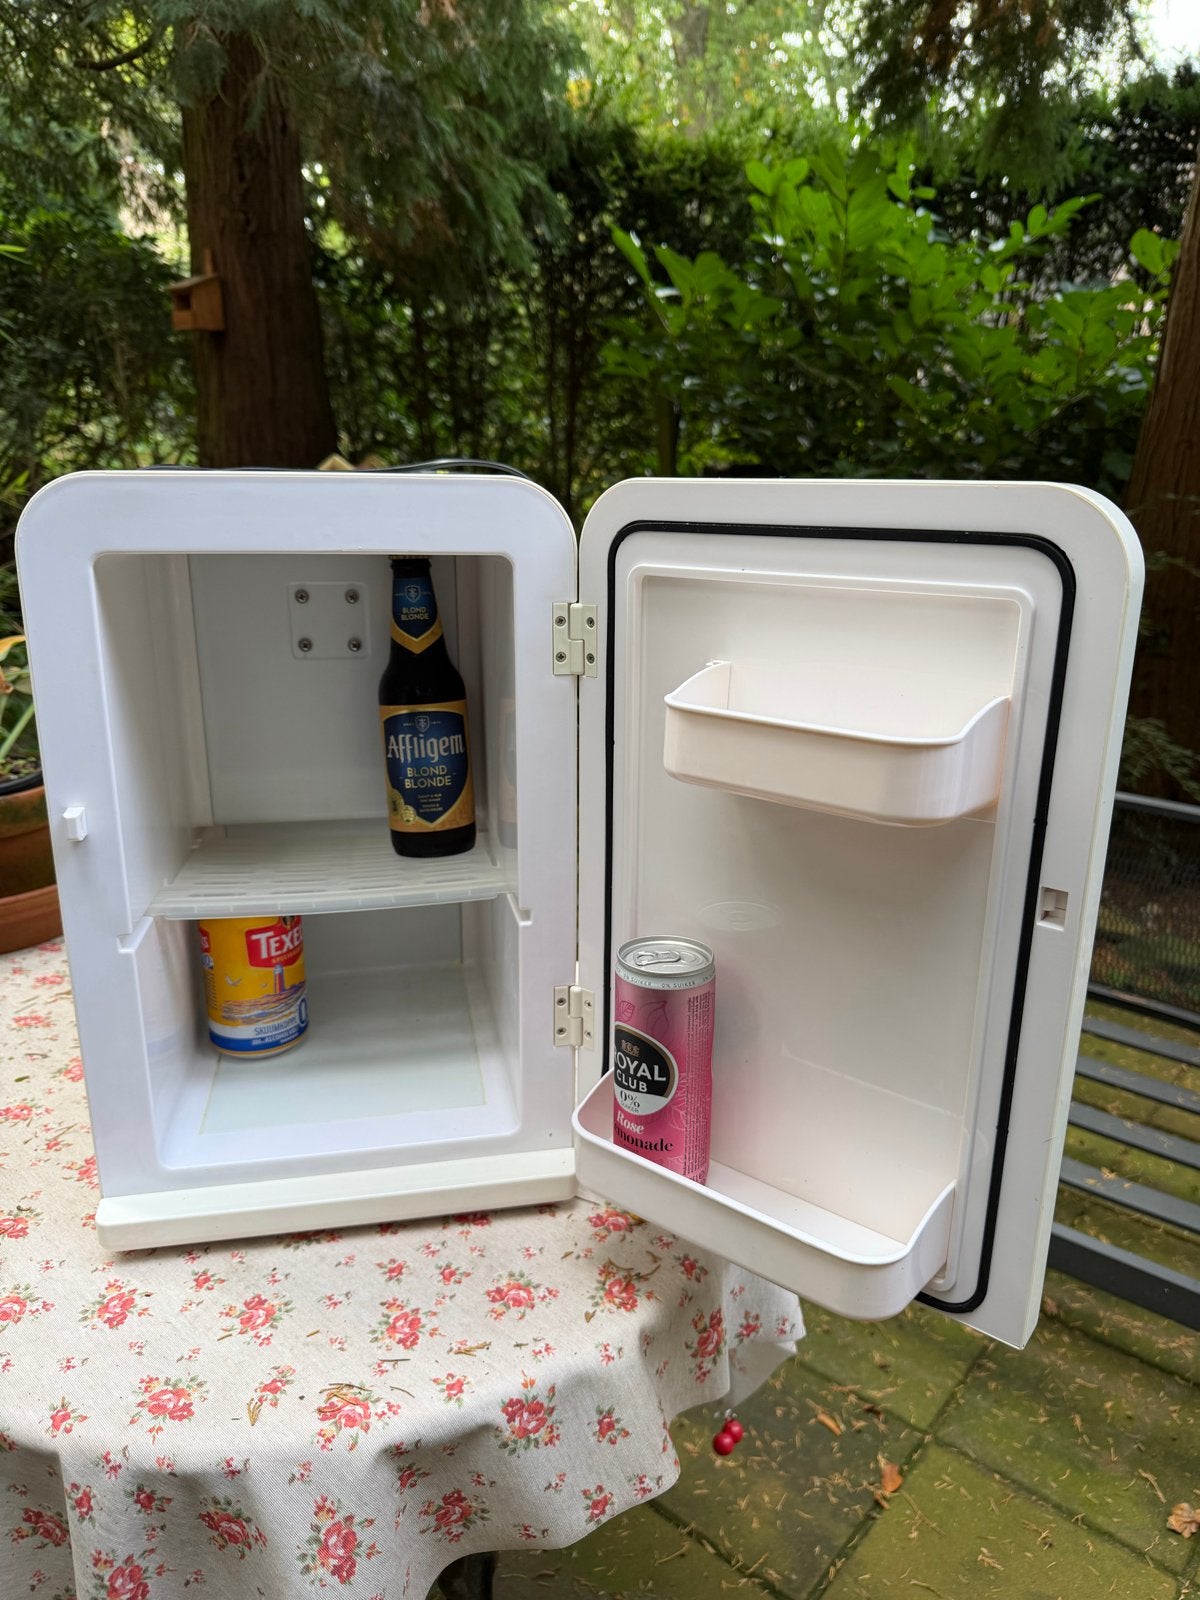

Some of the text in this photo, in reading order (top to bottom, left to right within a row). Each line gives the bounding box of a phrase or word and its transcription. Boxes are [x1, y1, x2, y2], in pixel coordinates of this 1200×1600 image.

[401, 613, 431, 621] BLONDE
[385, 734, 465, 763] Affligem
[404, 776, 452, 789] BLONDE
[407, 765, 448, 778] BLOND
[250, 926, 303, 960] TEXE
[616, 1069, 648, 1093] CLUB
[620, 1090, 640, 1108] 0%
[616, 1110, 644, 1134] Rose
[614, 1123, 673, 1152] monade
